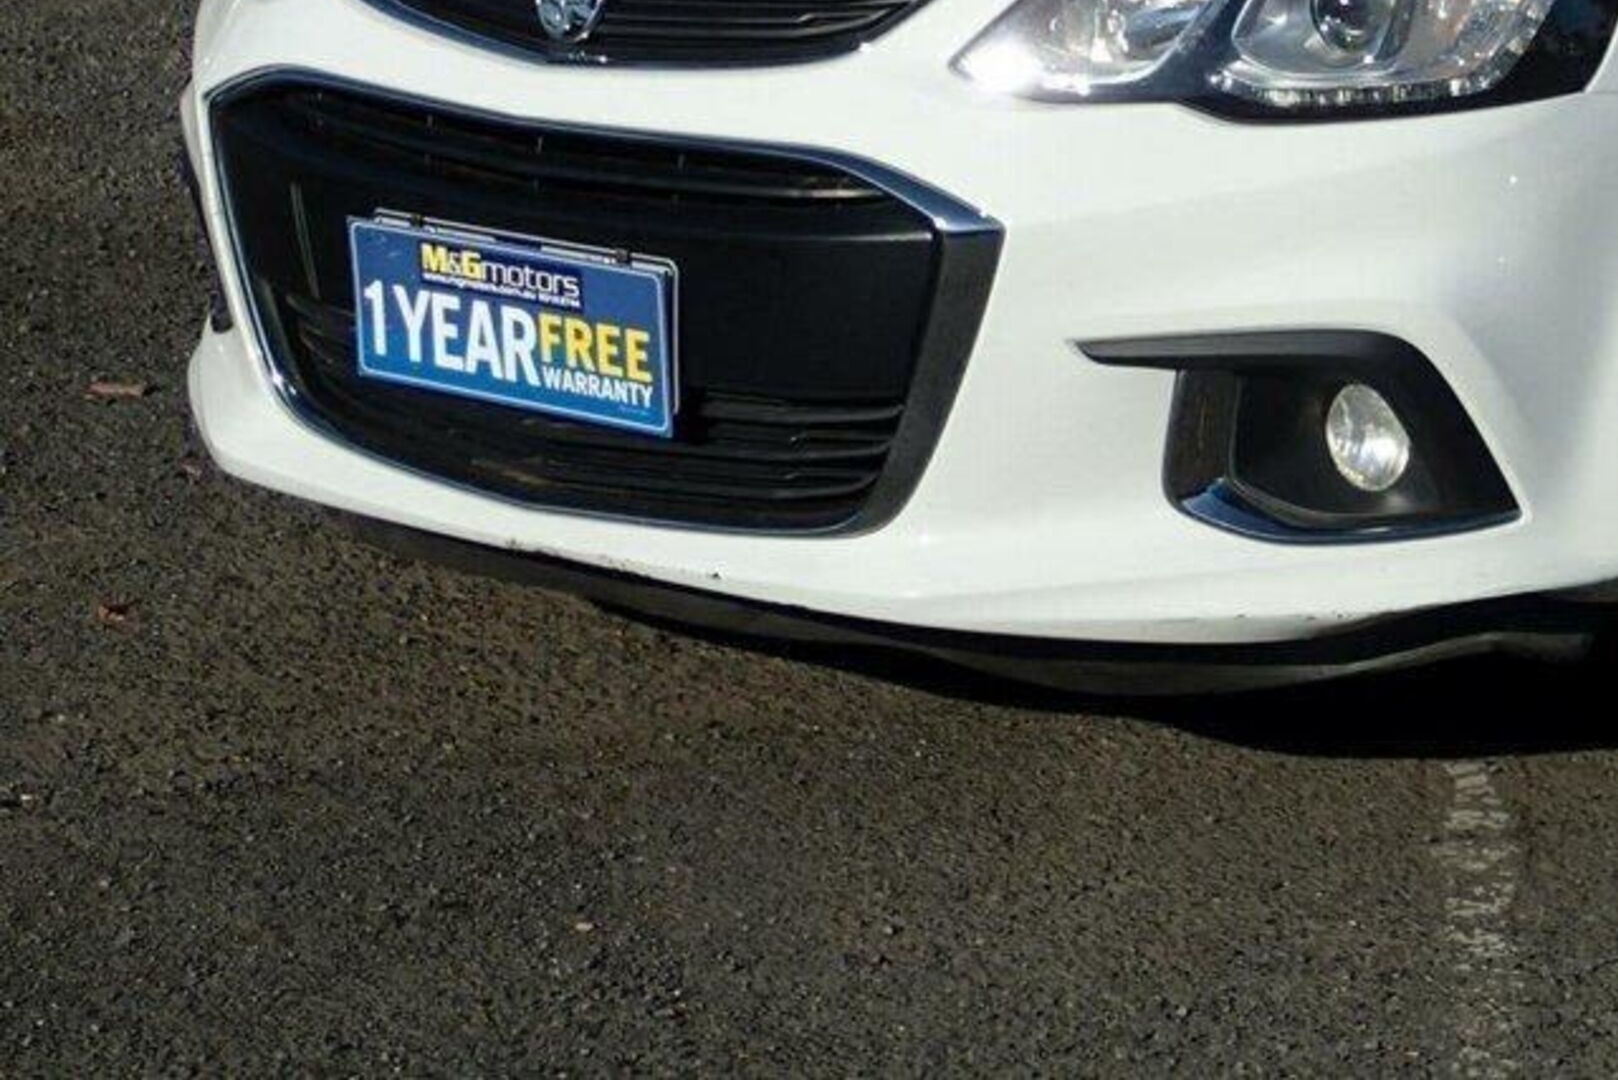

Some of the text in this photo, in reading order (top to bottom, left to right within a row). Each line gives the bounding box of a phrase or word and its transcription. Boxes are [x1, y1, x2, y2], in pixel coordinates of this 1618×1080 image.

[364, 279, 387, 357] 1
[393, 284, 540, 387] YEAR
[538, 312, 653, 383] FREE
[541, 366, 654, 409] WARRANTY
